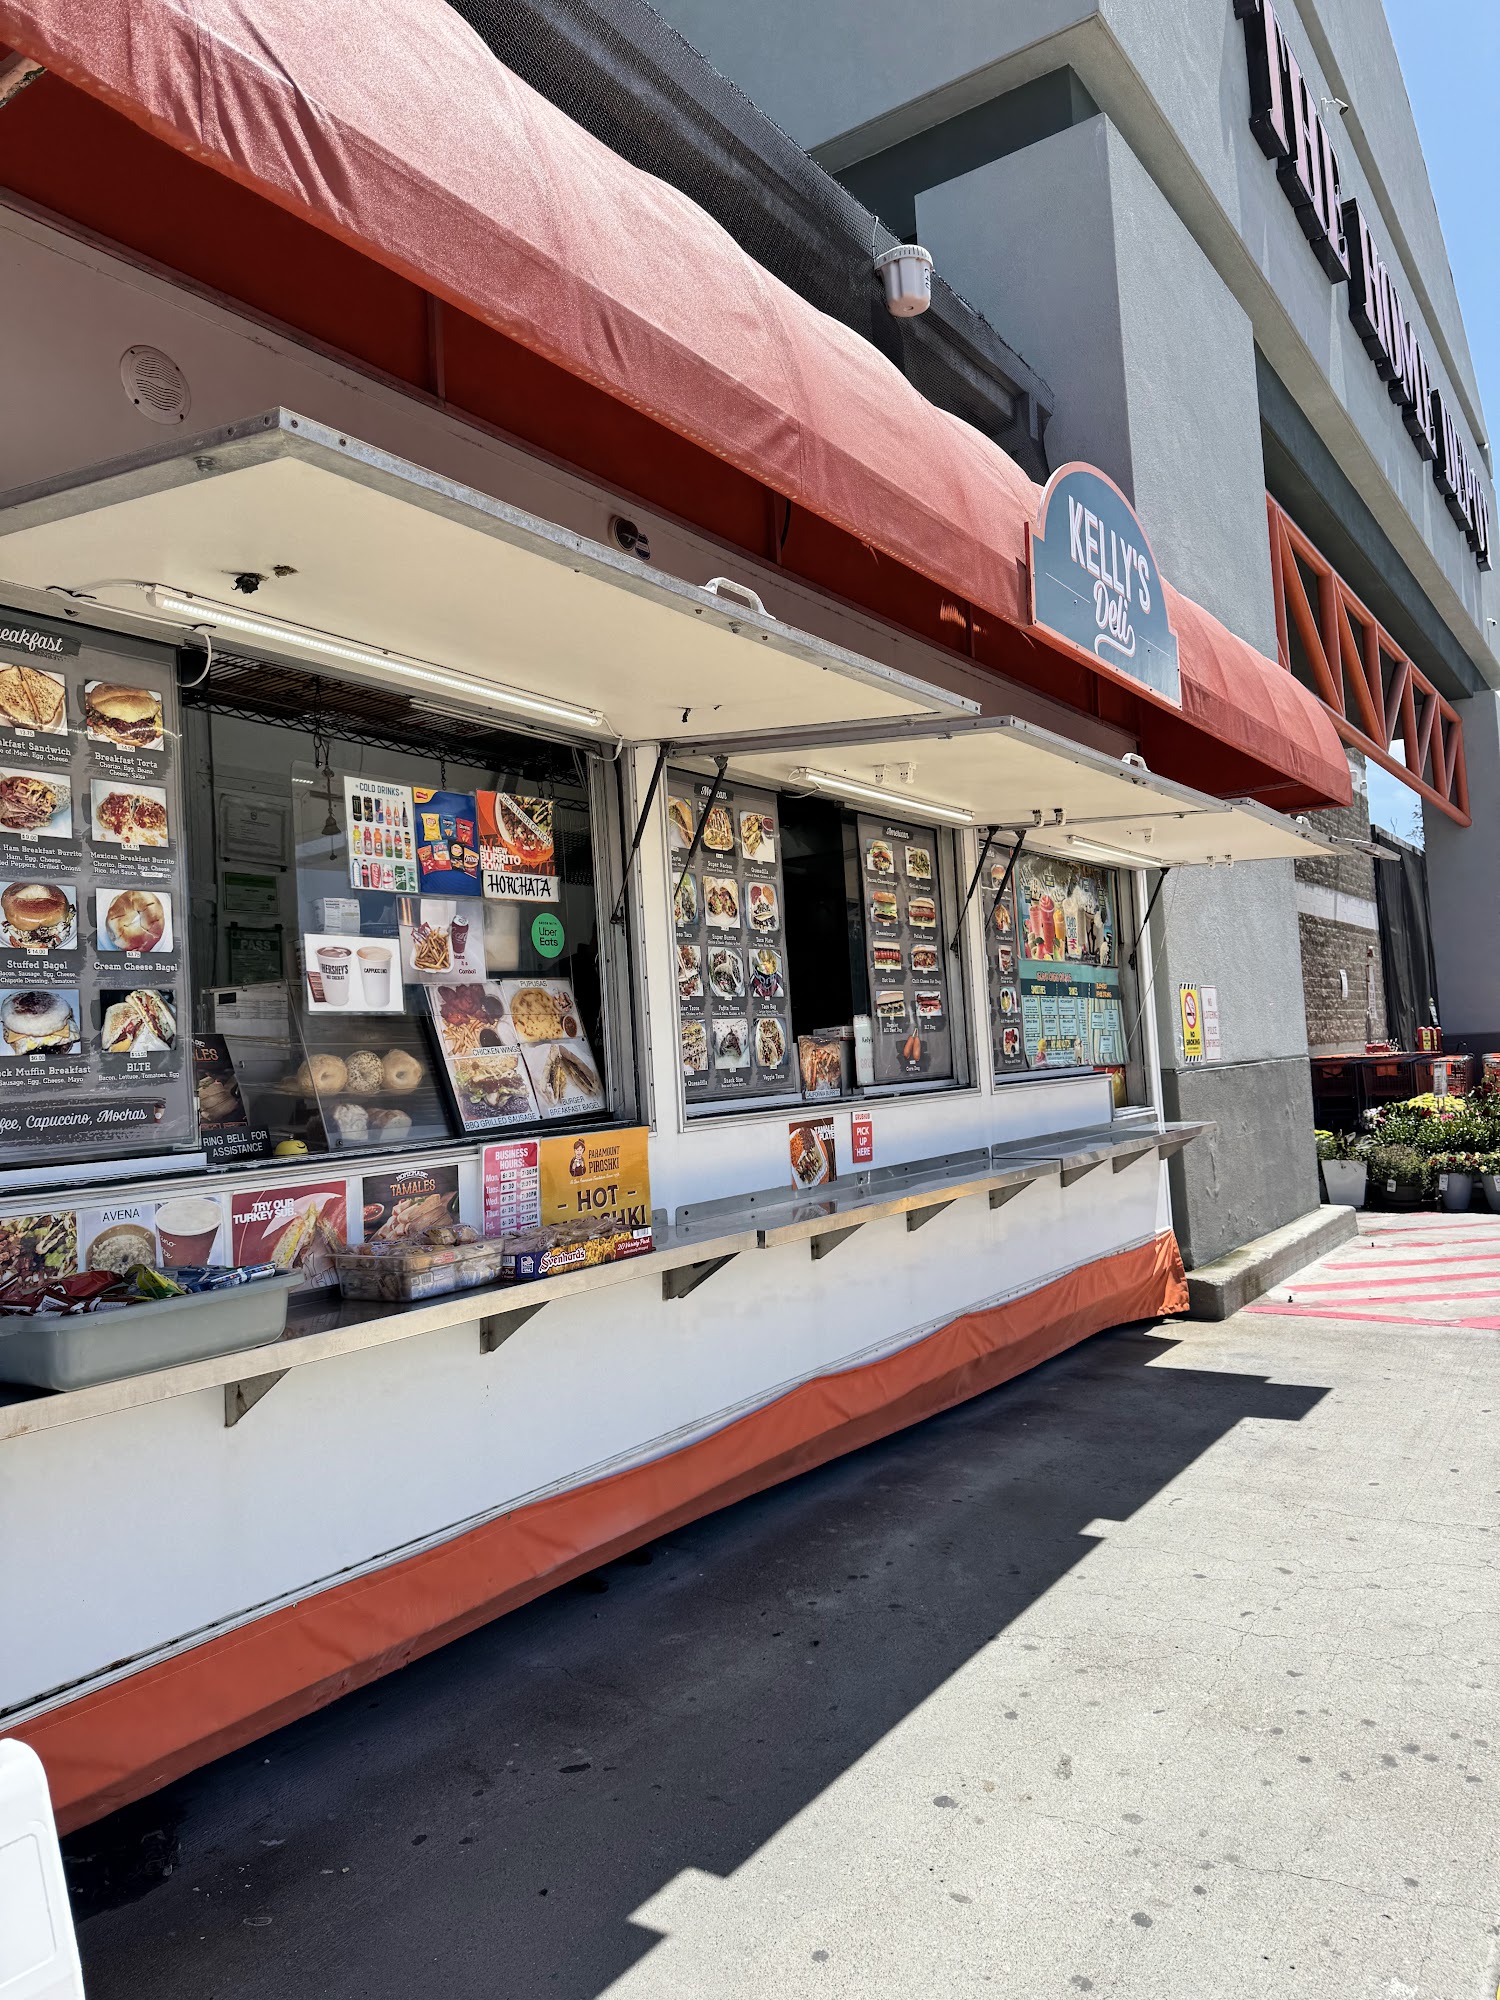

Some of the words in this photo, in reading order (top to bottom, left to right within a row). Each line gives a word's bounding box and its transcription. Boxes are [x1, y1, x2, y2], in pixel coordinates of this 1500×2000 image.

[1068, 494, 1151, 615] KELLY'S
[1093, 579, 1136, 658] Deli
[0, 628, 64, 652] eakfast
[28, 742, 72, 756] Sandwich
[94, 752, 135, 765] Breakfast
[137, 758, 159, 769] Torta
[359, 782, 376, 793] COLD
[377, 785, 400, 797] DRINKS
[501, 794, 531, 826] HEALTHIER
[530, 823, 553, 845] OPTION
[3, 844, 20, 852] Ham
[21, 845, 56, 855] Breakfast
[57, 848, 83, 857] Burrito
[480, 845, 492, 853] ALL
[492, 846, 508, 854] NEW
[90, 851, 119, 860] Mexican
[120, 853, 151, 863] Breakfast
[152, 856, 175, 865] Burrito
[480, 852, 521, 865] BURRITO
[487, 874, 552, 898] HORCHATA
[538, 926, 557, 936] Uber
[240, 939, 271, 951] PASS
[539, 936, 559, 946] Eats
[7, 960, 40, 969] Stuffed
[43, 961, 68, 971] Bagel
[93, 962, 121, 970] Cream
[124, 962, 153, 971] Cheese
[155, 963, 178, 972] Bagel
[321, 963, 349, 975] HERSHEY'S
[1186, 1038, 1200, 1046] SMOKING
[472, 1047, 500, 1056] CHICKEN
[500, 1045, 521, 1054] WINGS
[15, 1067, 46, 1077] Muffin
[48, 1065, 91, 1075] Breakfast
[126, 1062, 151, 1072] BLTE
[806, 1090, 825, 1098] CALIFORNIA
[562, 1095, 585, 1106] BURGER
[549, 1105, 582, 1117] BREAKFAST
[582, 1101, 602, 1110] BAGEL
[26, 1112, 94, 1131] Capuccino,
[97, 1108, 147, 1123] Mochas
[465, 1121, 480, 1130] BBQ
[480, 1116, 508, 1128] GRILLED
[508, 1112, 537, 1124] SAUSAGE
[813, 1124, 835, 1134] TAMALE
[856, 1126, 870, 1136] PICK
[202, 1136, 224, 1147] RING
[226, 1133, 248, 1144] BELL
[250, 1130, 268, 1141] FOR
[819, 1132, 835, 1140] PLATE
[859, 1137, 868, 1146] UP
[212, 1142, 263, 1158] ASSISTANCE
[495, 1147, 529, 1160] BUSINESS
[588, 1145, 620, 1159] PARAMOUNT
[856, 1146, 871, 1157] HERE
[500, 1158, 525, 1170] HOURS:
[588, 1157, 620, 1173] PIROSHKI
[395, 1170, 429, 1182] HOMEMADE
[485, 1174, 499, 1182] Mon.
[390, 1178, 436, 1197] TAMALES
[485, 1186, 500, 1194] Tues.
[485, 1198, 499, 1206] Wed.
[577, 1184, 619, 1212] HOT
[251, 1201, 273, 1213] TRY
[273, 1198, 295, 1209] OUR
[102, 1208, 140, 1222] AVENA
[232, 1211, 275, 1225] TURKEY
[275, 1207, 298, 1218] SUB.
[486, 1210, 499, 1218] Thur.
[485, 1221, 495, 1230] Fri.
[617, 1243, 625, 1251] 20
[538, 1247, 586, 1273] Svenhard's
